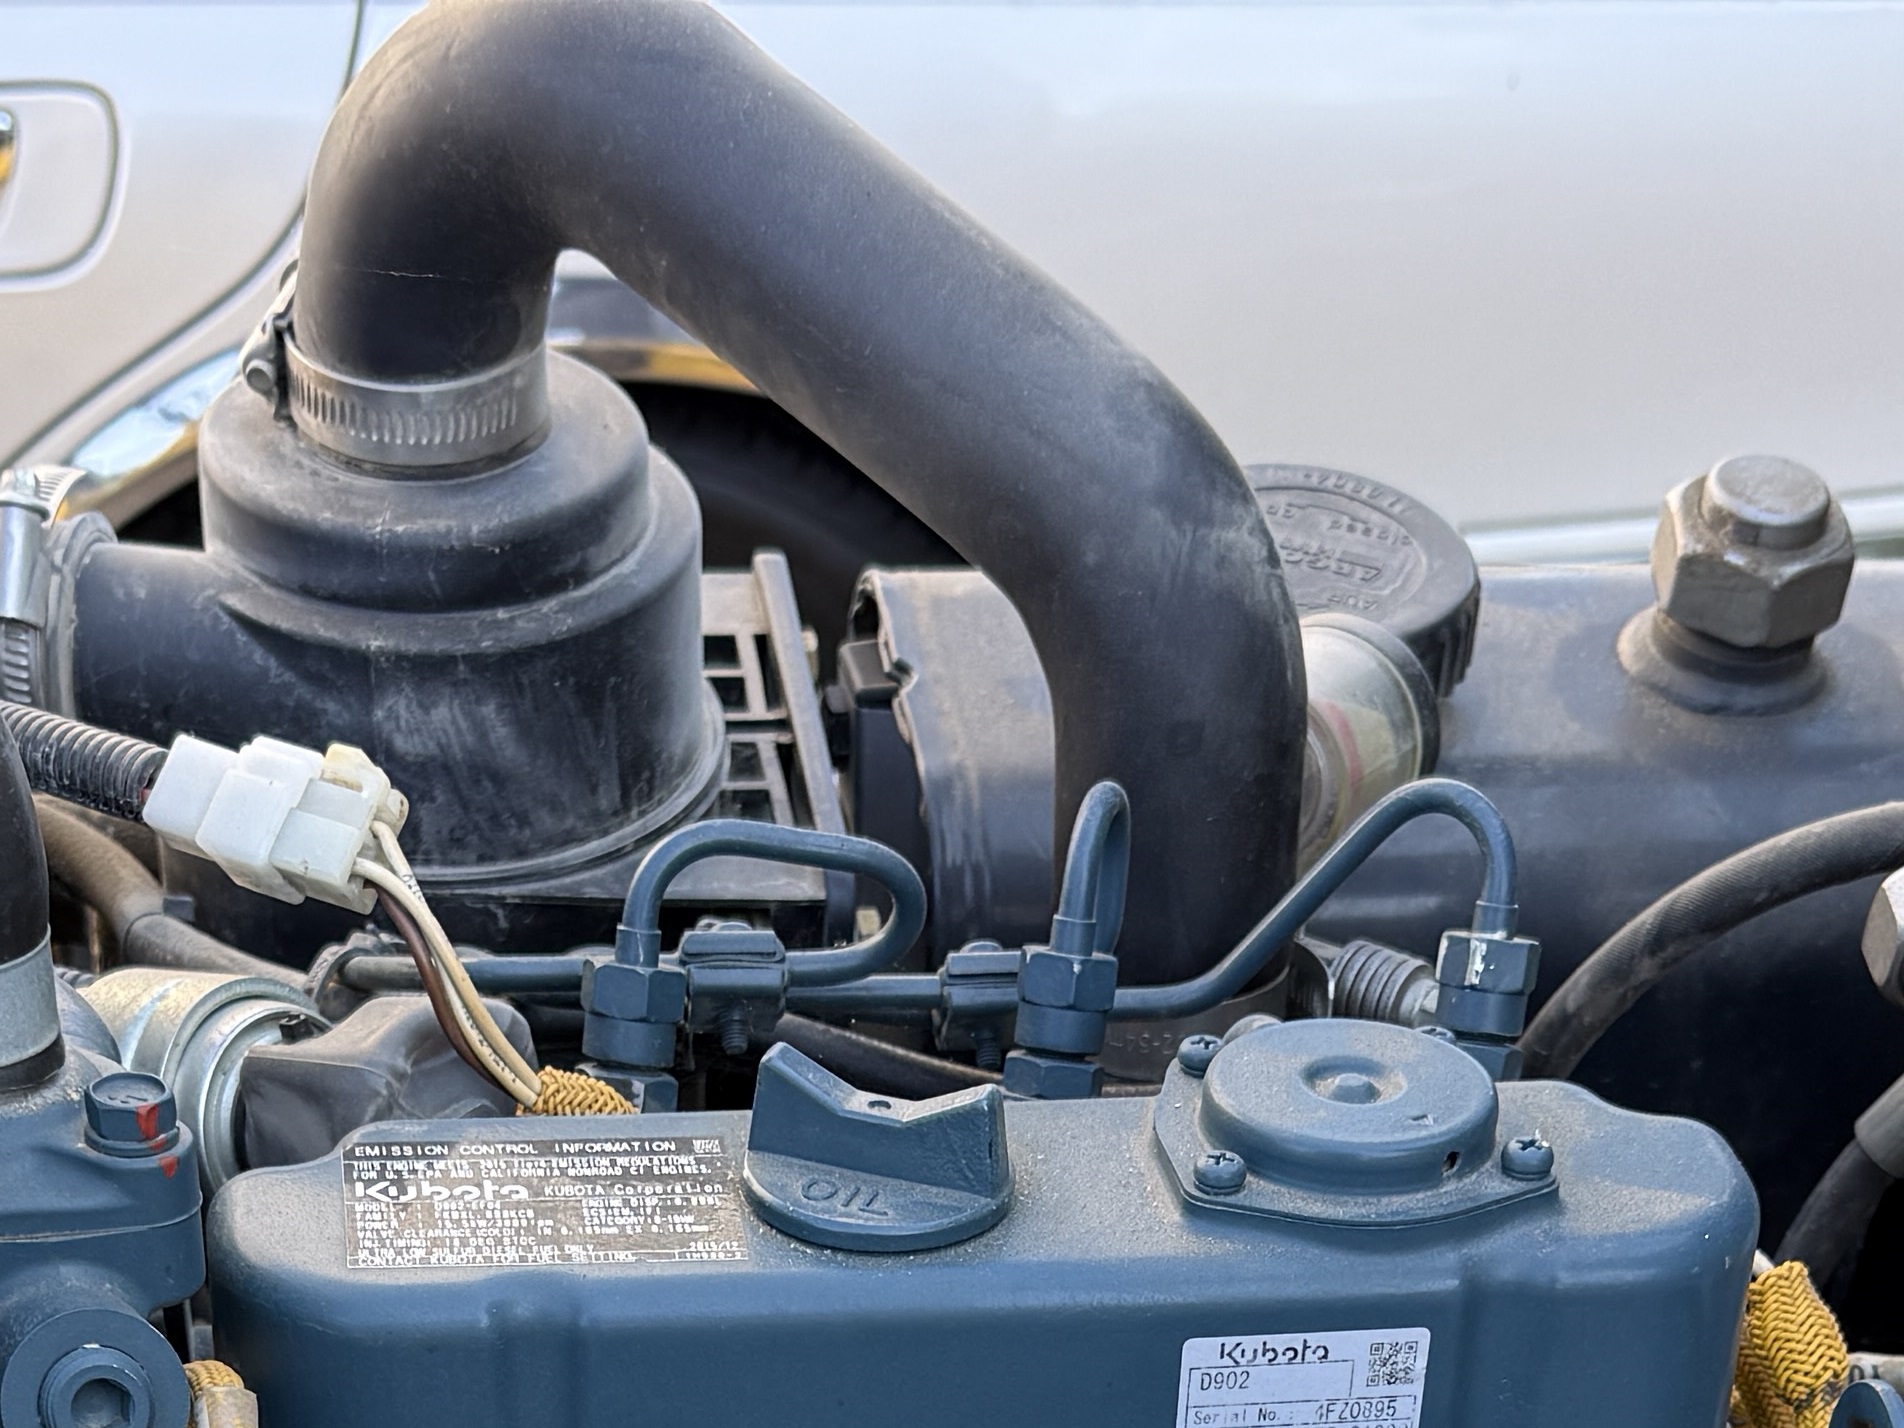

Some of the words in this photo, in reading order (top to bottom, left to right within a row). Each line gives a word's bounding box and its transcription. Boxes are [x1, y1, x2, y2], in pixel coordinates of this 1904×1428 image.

[354, 1145, 449, 1157] EMISSION
[459, 1143, 538, 1155] CONTROL
[555, 1140, 676, 1153] INFORMATION
[354, 1179, 529, 1202] Kubota
[545, 1185, 605, 1197] KUBOTA
[613, 1183, 723, 1195] Corporation
[800, 1178, 889, 1216] OIL
[1219, 1339, 1330, 1365] Kubota
[1200, 1370, 1251, 1391] D902
[1193, 1409, 1247, 1425] Serial
